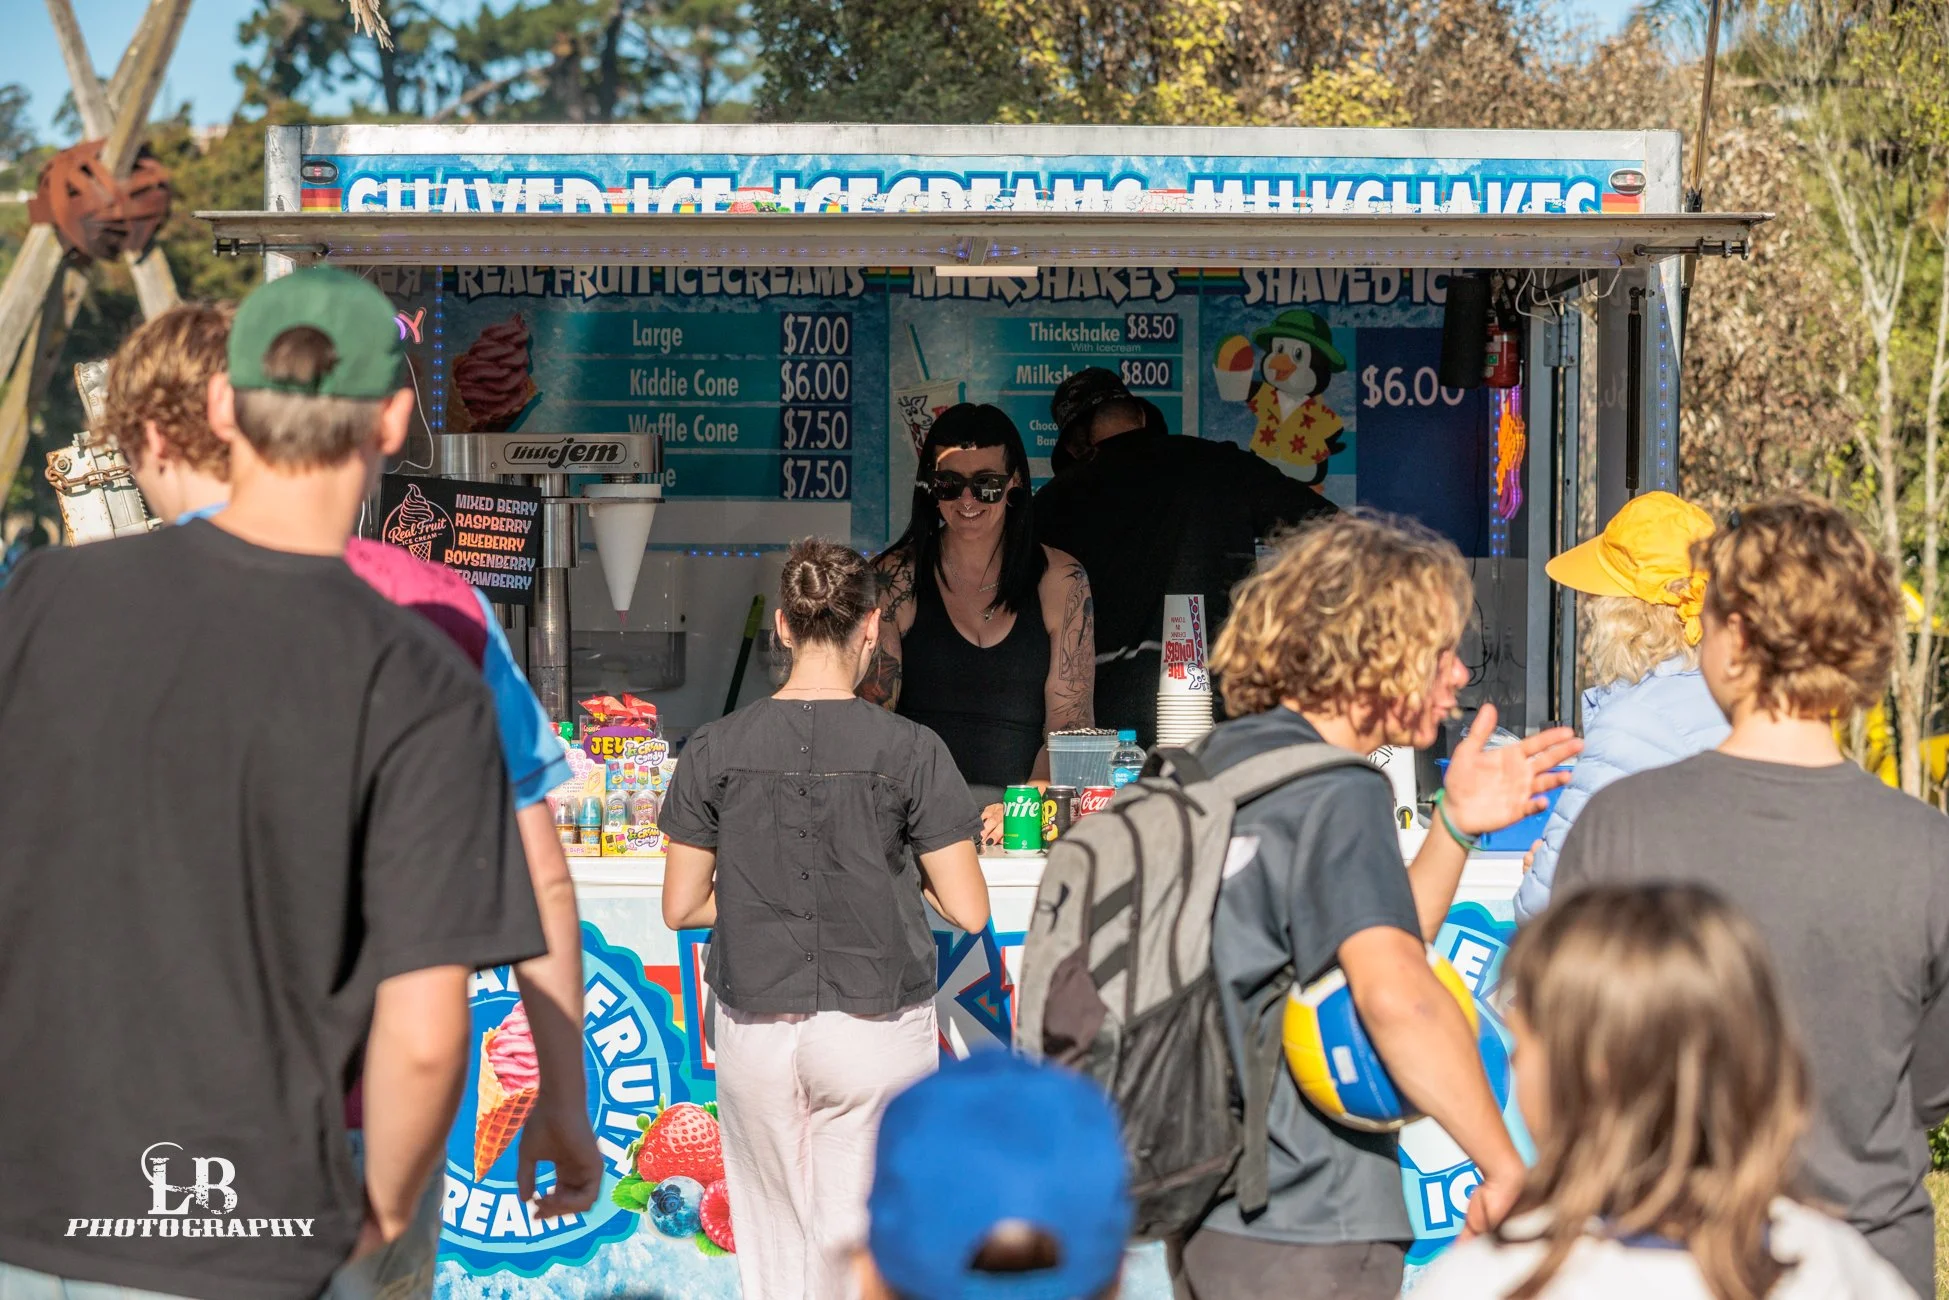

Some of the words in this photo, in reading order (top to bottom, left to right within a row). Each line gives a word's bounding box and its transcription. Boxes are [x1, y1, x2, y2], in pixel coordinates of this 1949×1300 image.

[458, 266, 543, 298] REAL
[554, 266, 654, 299] FRUIT
[665, 266, 866, 299] ICECREAMS
[1246, 267, 1401, 304] SHAVED
[1412, 267, 1464, 304] IC
[632, 319, 683, 354] Large
[783, 313, 849, 355] $7.00
[1029, 322, 1121, 342] Thickshake
[1127, 313, 1176, 340] $8.50
[1071, 342, 1093, 352] With
[1096, 342, 1142, 352] Icecream
[629, 367, 688, 397] Kiddie
[693, 368, 739, 397] Cone
[781, 360, 849, 402] $6.00
[1016, 363, 1090, 385] Milksh
[1121, 361, 1170, 386] $8.00
[628, 412, 688, 442] Waffle
[693, 413, 739, 442] Cone
[783, 408, 848, 450] $7.50
[783, 457, 848, 500] $7.50
[455, 493, 494, 513] MIXED
[496, 497, 538, 517] BERRY
[388, 522, 417, 544] Real
[416, 517, 447, 535] Fruit
[455, 512, 532, 534] RASPBERRY
[458, 531, 525, 552] BLUEBERRY
[444, 549, 536, 572] BOYSENBERRY
[1164, 639, 1195, 663] LONGEST
[1168, 663, 1187, 680] THE
